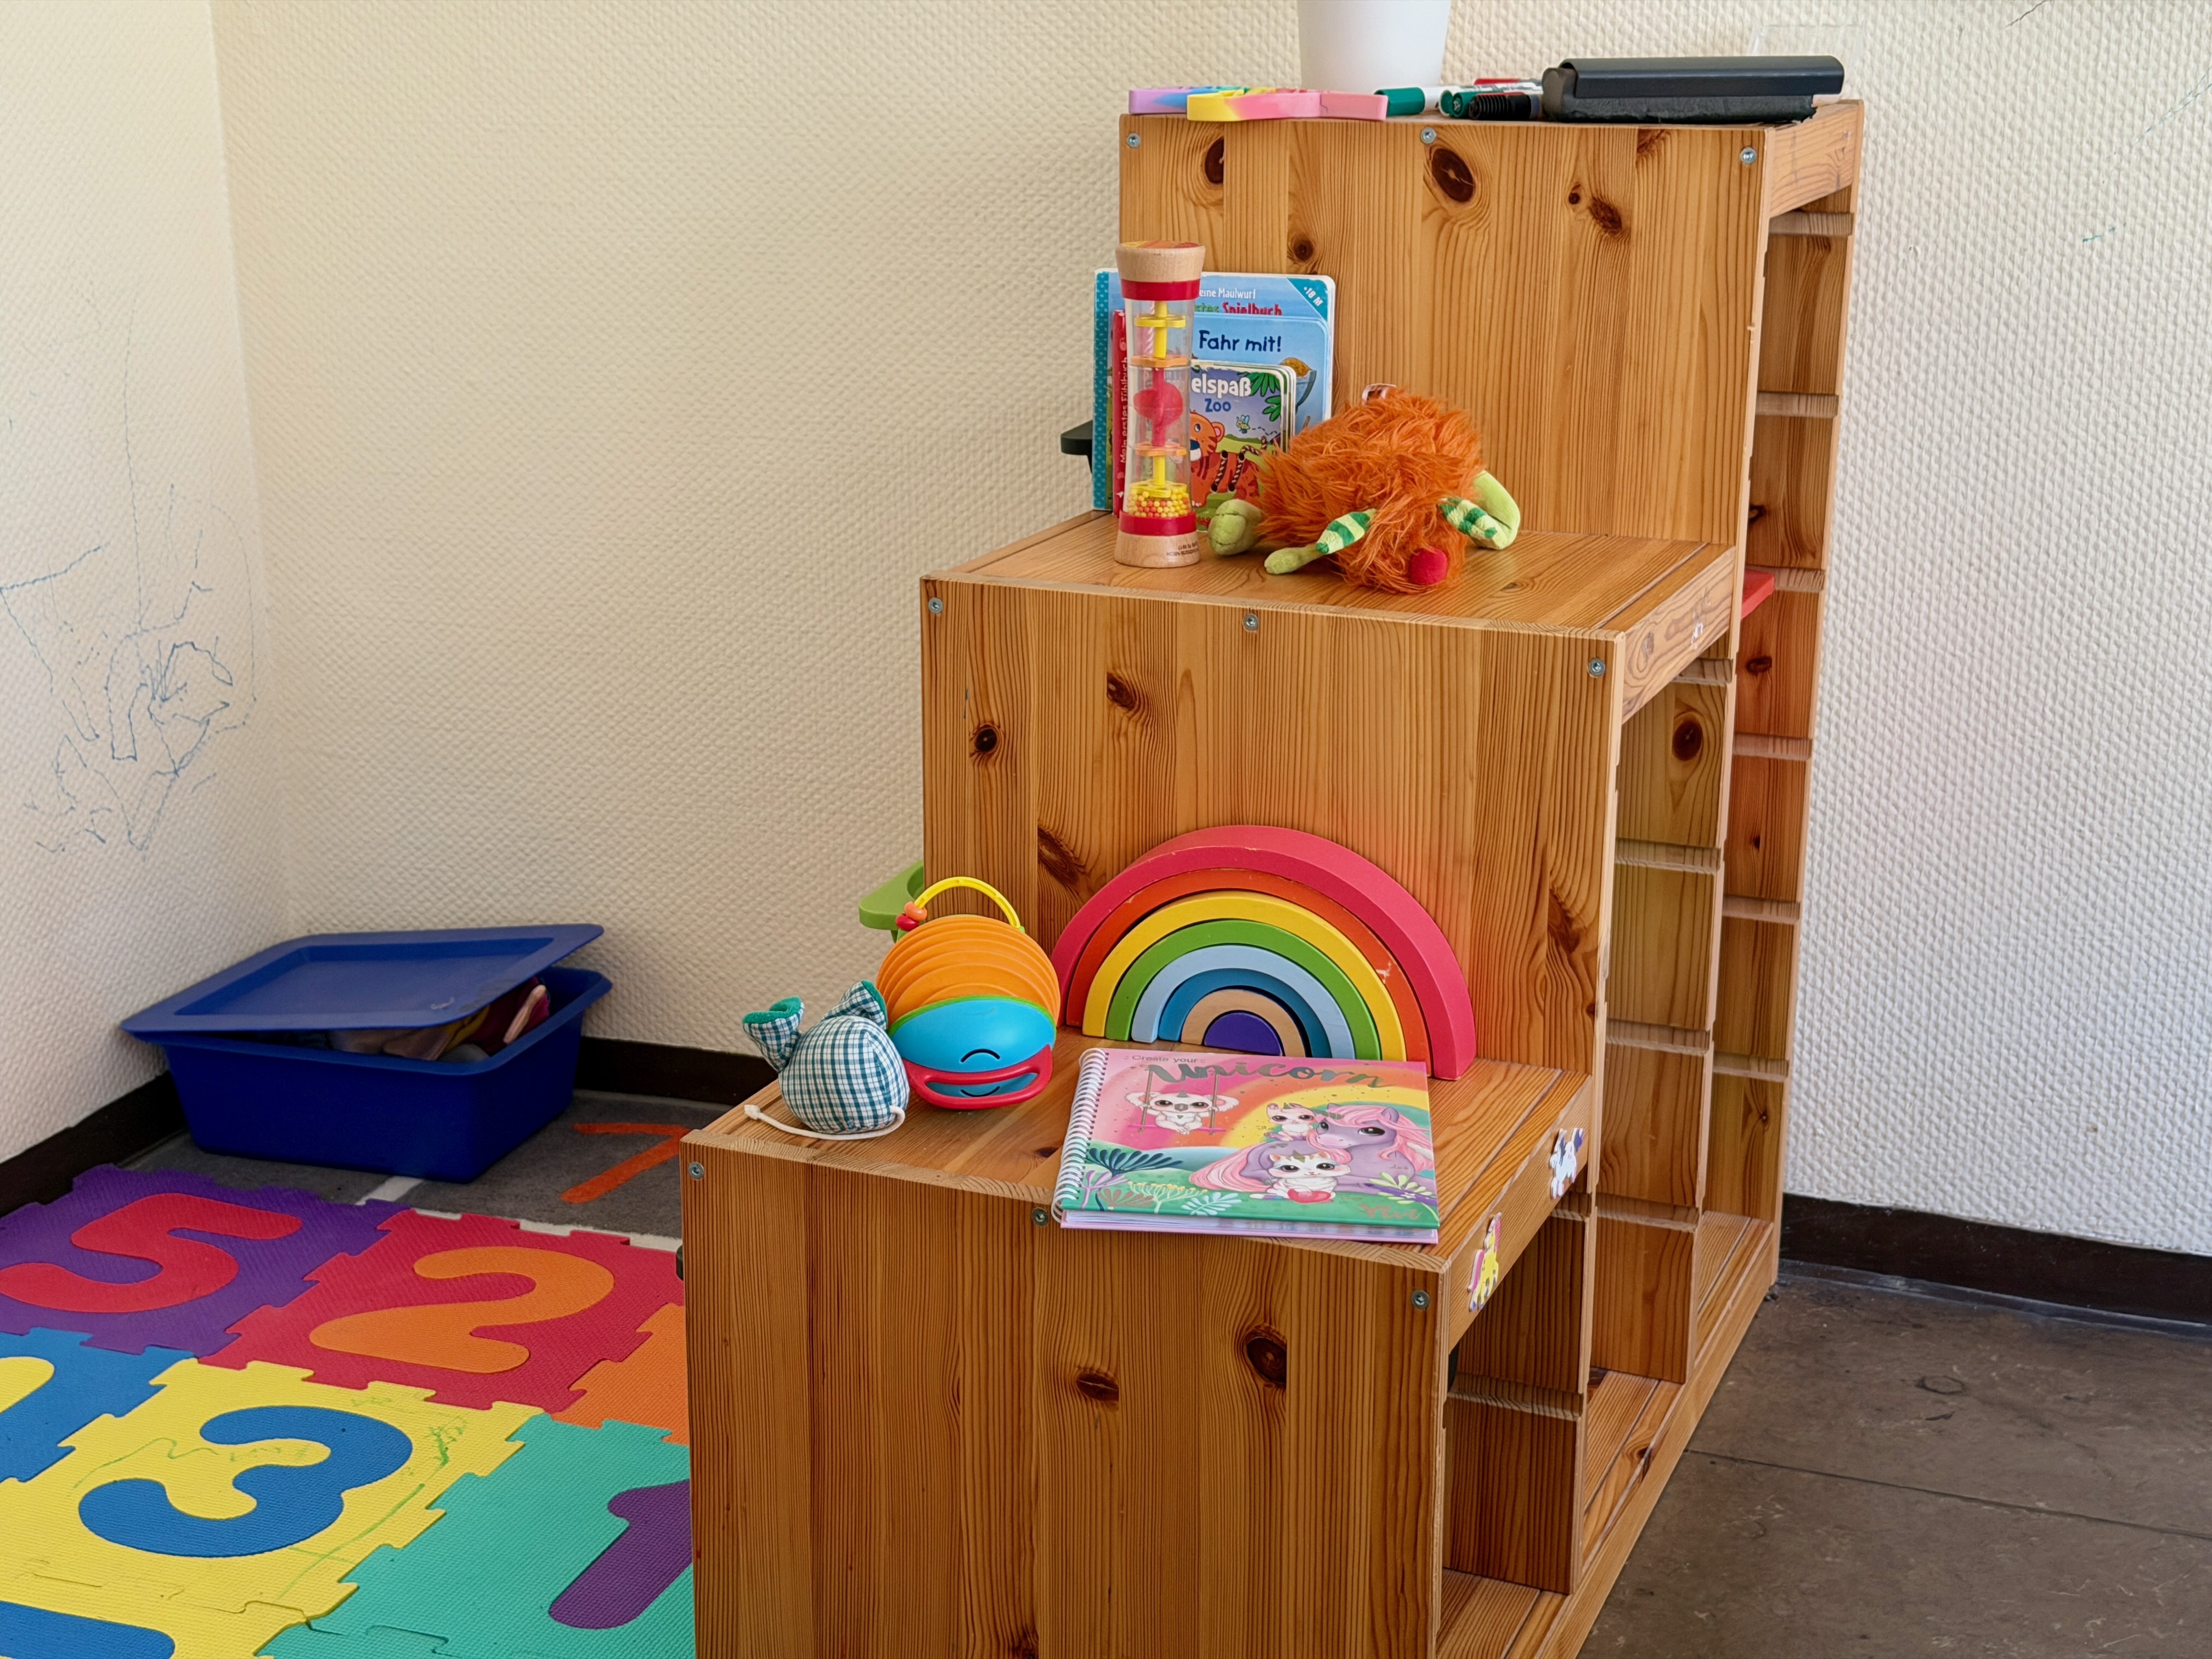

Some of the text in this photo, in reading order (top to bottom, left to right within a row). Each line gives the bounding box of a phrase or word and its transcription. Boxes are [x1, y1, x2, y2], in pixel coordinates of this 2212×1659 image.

[1218, 287, 1256, 300] Maulwurf
[1312, 296, 1324, 307] M
[1199, 329, 1282, 353] Fahr mit!
[1190, 373, 1251, 399] elspaß
[1204, 398, 1232, 413] Zoo
[1145, 1062, 1396, 1088] Unicorn
[309, 1245, 615, 1374] 2
[78, 1404, 413, 1558] 3
